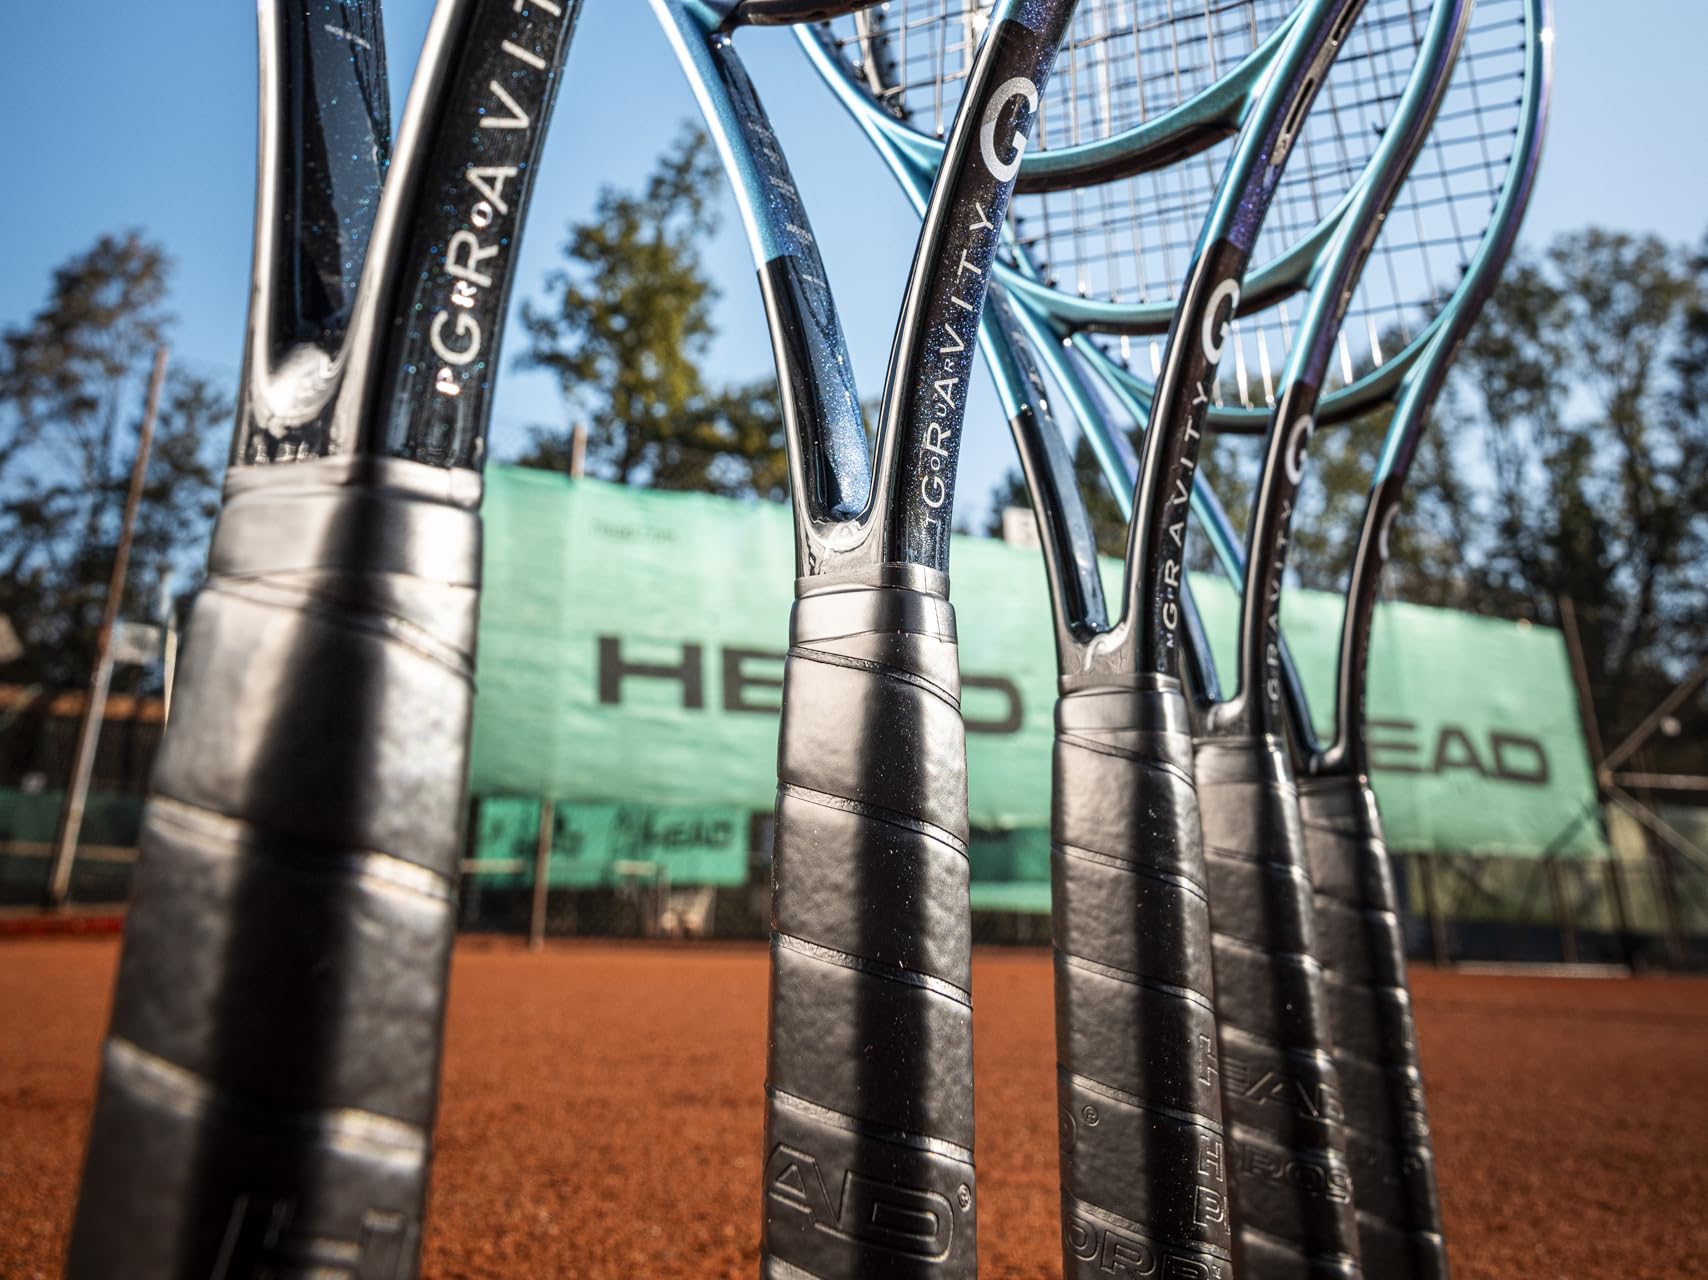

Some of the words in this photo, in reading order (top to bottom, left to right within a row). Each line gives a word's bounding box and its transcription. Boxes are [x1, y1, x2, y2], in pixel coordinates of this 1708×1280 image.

[979, 76, 1038, 182] G
[922, 202, 995, 510] GRAVITY
[1202, 278, 1240, 365] G
[1163, 380, 1209, 630] GRAVITY
[1367, 719, 1549, 786] EAD
